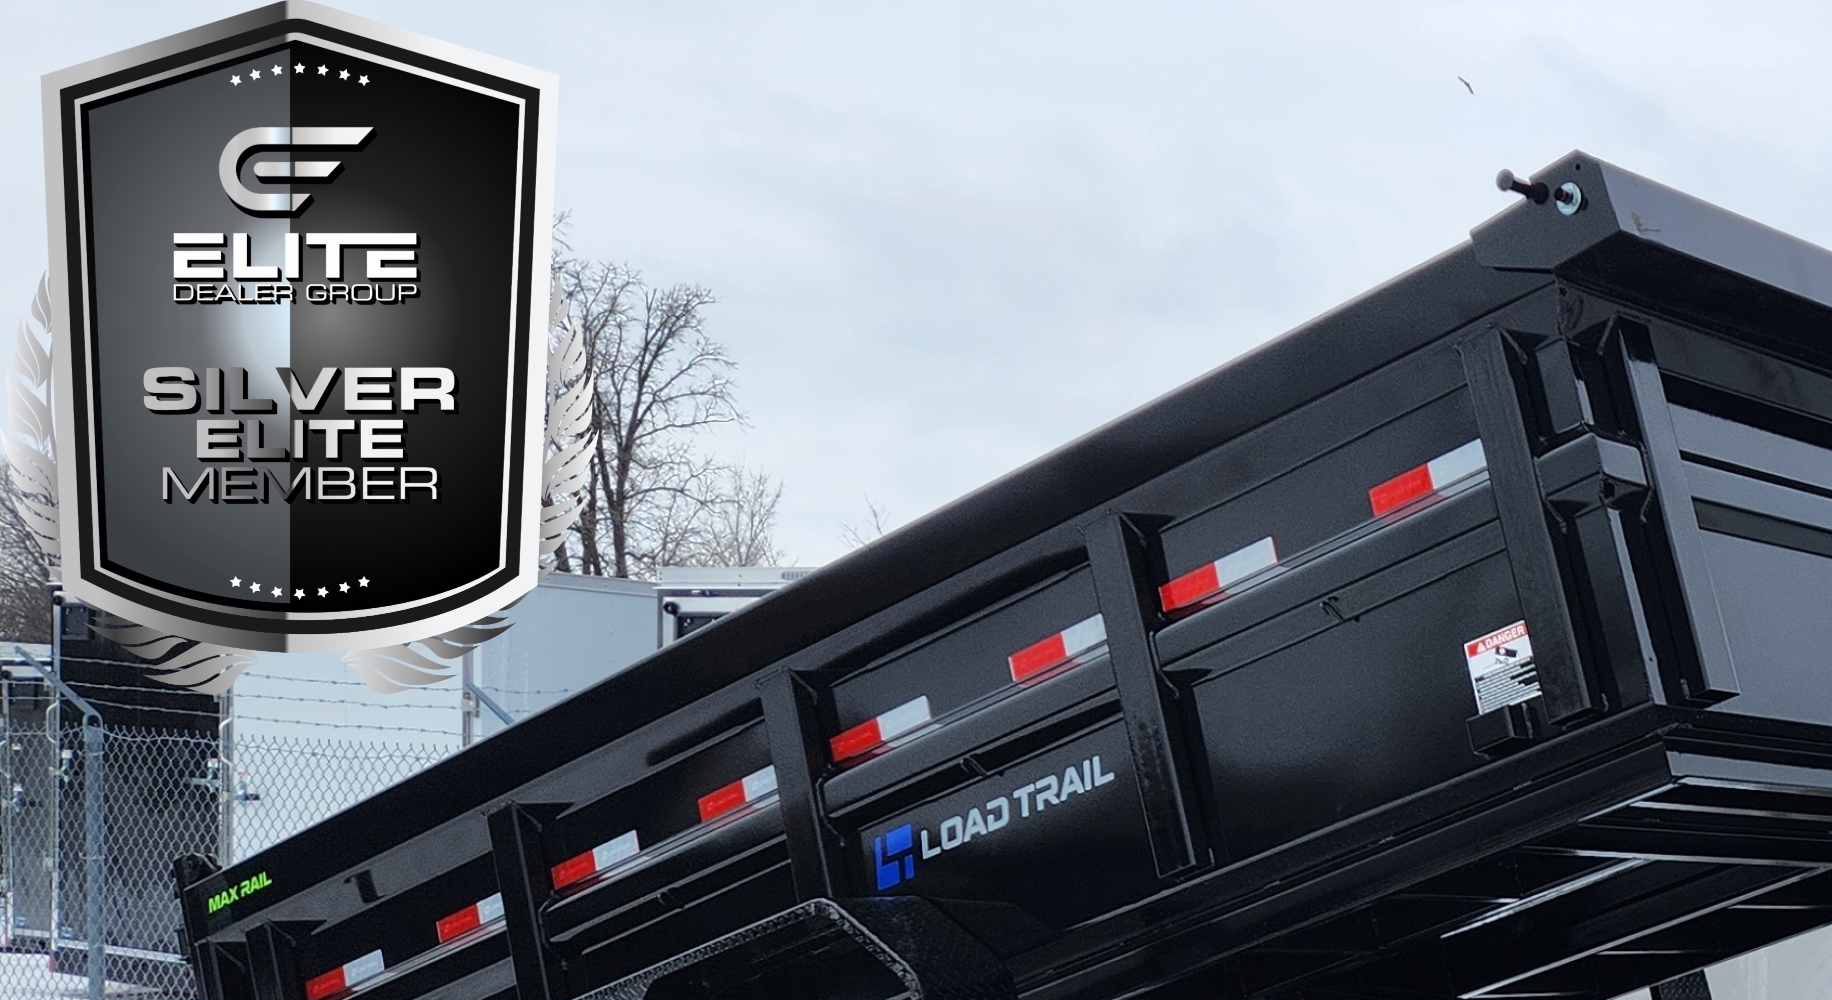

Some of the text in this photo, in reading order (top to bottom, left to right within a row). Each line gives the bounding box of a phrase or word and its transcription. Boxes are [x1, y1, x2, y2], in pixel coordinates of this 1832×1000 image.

[1485, 625, 1526, 649] DANGER
[920, 755, 1115, 860] LOAD TRAIL
[208, 871, 272, 914] MAX RAIL
